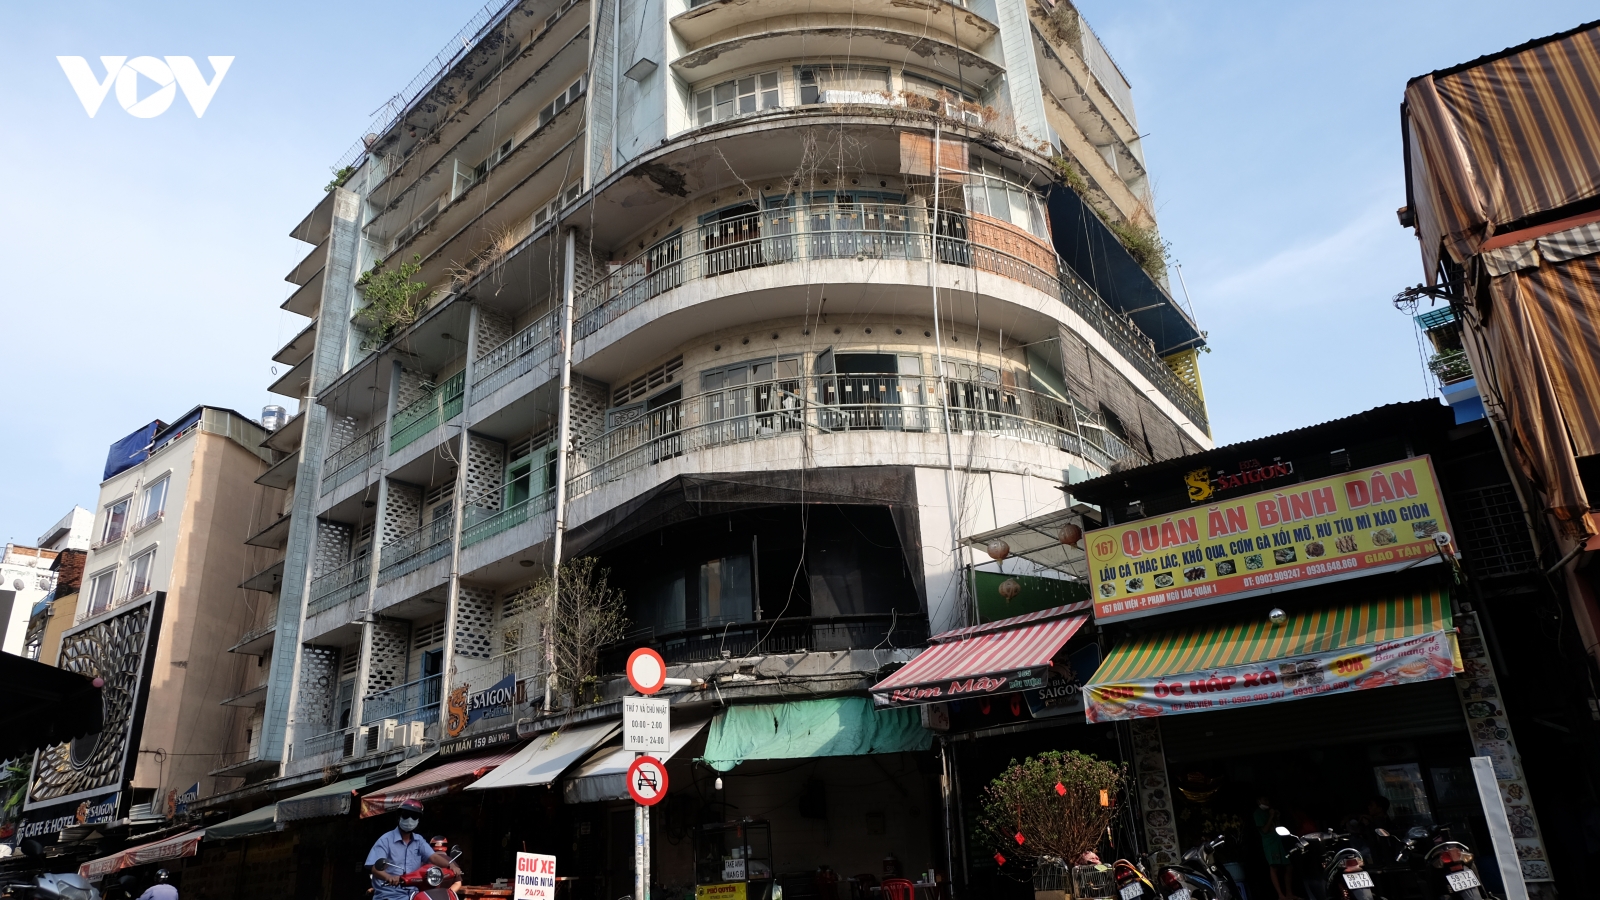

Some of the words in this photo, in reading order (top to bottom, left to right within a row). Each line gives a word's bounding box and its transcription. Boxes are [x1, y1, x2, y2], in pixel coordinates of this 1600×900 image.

[1239, 458, 1260, 470] BIA
[1218, 462, 1288, 490] SAIGON
[1121, 516, 1199, 558] QUÁN
[1208, 506, 1249, 540] ĂN
[1256, 486, 1337, 528] BÌNH
[1344, 468, 1419, 510] DÂN
[1095, 540, 1114, 556] 167
[1099, 564, 1116, 582] LẨU
[1119, 562, 1132, 578] CÁ
[1133, 557, 1158, 576] THÁC
[1160, 554, 1180, 570] LÁC,
[1182, 544, 1204, 563] KHỔ
[1206, 544, 1228, 561] QUA,
[1230, 538, 1254, 556] CƠM
[1256, 532, 1271, 550] GÀ
[1272, 528, 1290, 546] XỐI
[1293, 524, 1314, 542] MỠ,
[1316, 520, 1332, 538] HỦ
[1334, 516, 1354, 534] TÍU
[1356, 512, 1372, 530] MÌ
[1374, 509, 1397, 527] XÀO
[1399, 502, 1430, 521] GIÒN
[1364, 548, 1393, 564] GIAO
[1396, 544, 1421, 559] TẬN
[1255, 568, 1300, 584] 0902.909247
[1306, 558, 1358, 576] 0938.648.860
[1102, 603, 1112, 614] 167
[1124, 598, 1139, 610] VIỆN
[1147, 593, 1166, 606] PHẠM
[1212, 584, 1217, 593] 1
[1374, 642, 1402, 652] Take
[1403, 635, 1437, 648] away
[1374, 652, 1395, 662] Bán
[1398, 647, 1424, 658] mang
[1428, 642, 1440, 652] về
[1336, 656, 1364, 674] 30K
[891, 686, 942, 702] Kim
[948, 675, 1006, 696] Mây
[1052, 678, 1066, 686] BIA
[1154, 677, 1185, 698] ỐC
[1189, 670, 1237, 694] HẤP
[1243, 667, 1278, 688] XẢ
[1270, 690, 1285, 699] 247
[1293, 681, 1349, 696] 0938.648.860
[473, 686, 512, 709] SAIGON
[1039, 683, 1082, 700] SAIGON
[1100, 686, 1135, 700] 30K
[626, 703, 634, 712] THỨ
[640, 704, 645, 713] VÀ
[646, 704, 655, 713] CHỦ
[656, 704, 667, 715] NHẬT
[440, 744, 455, 755] MAY
[474, 737, 486, 748] 159
[650, 736, 664, 744] 24:00
[178, 791, 197, 804] SAIGON
[90, 802, 115, 816] SAIGON
[24, 820, 43, 838] CAFE
[43, 821, 50, 833] &
[540, 860, 554, 874] XE
[518, 875, 538, 886] TRONG
